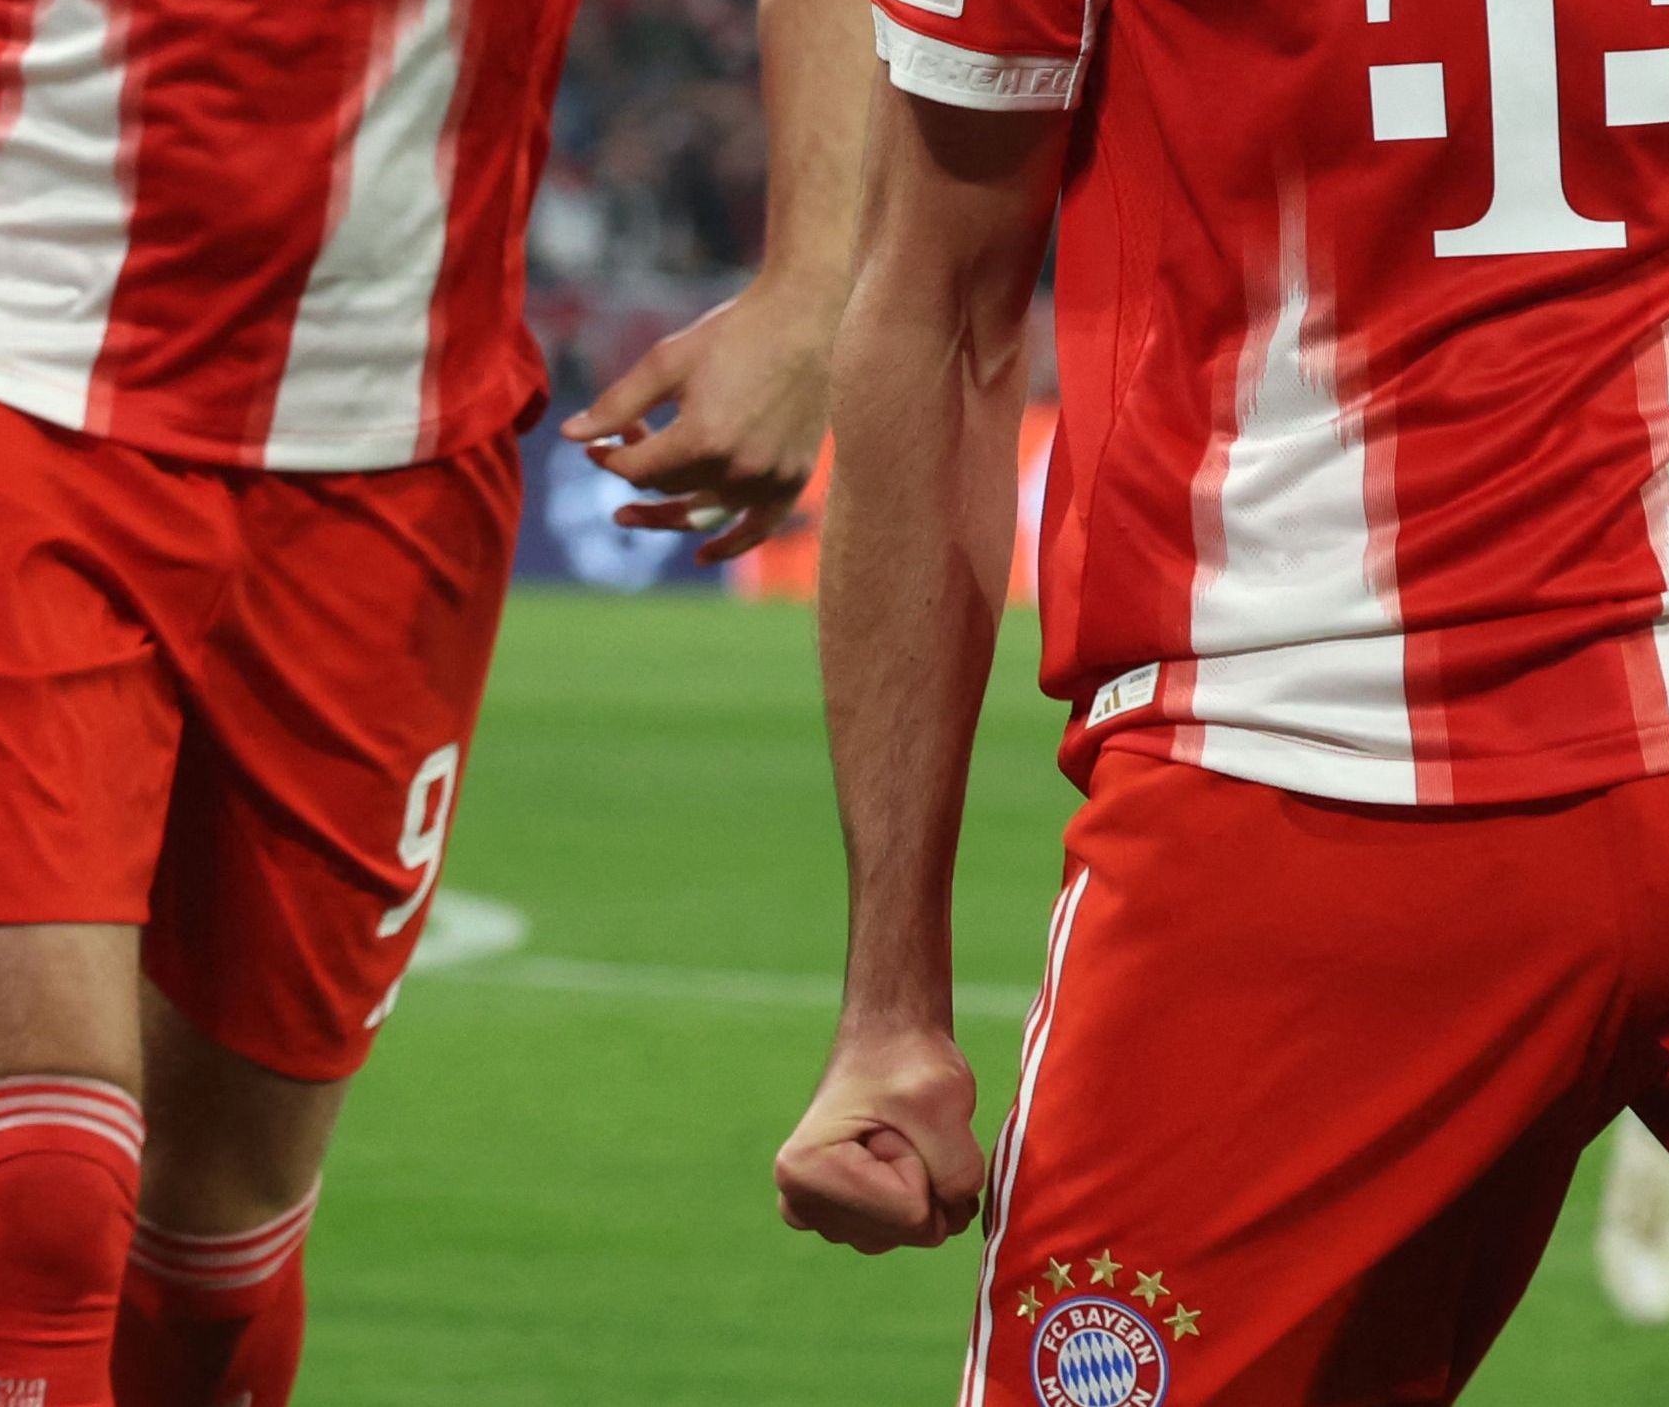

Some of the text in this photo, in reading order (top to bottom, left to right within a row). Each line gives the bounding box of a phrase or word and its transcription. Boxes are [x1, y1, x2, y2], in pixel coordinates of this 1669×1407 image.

[376, 741, 459, 938] 9
[1043, 1307, 1156, 1365] FC BAYERN
